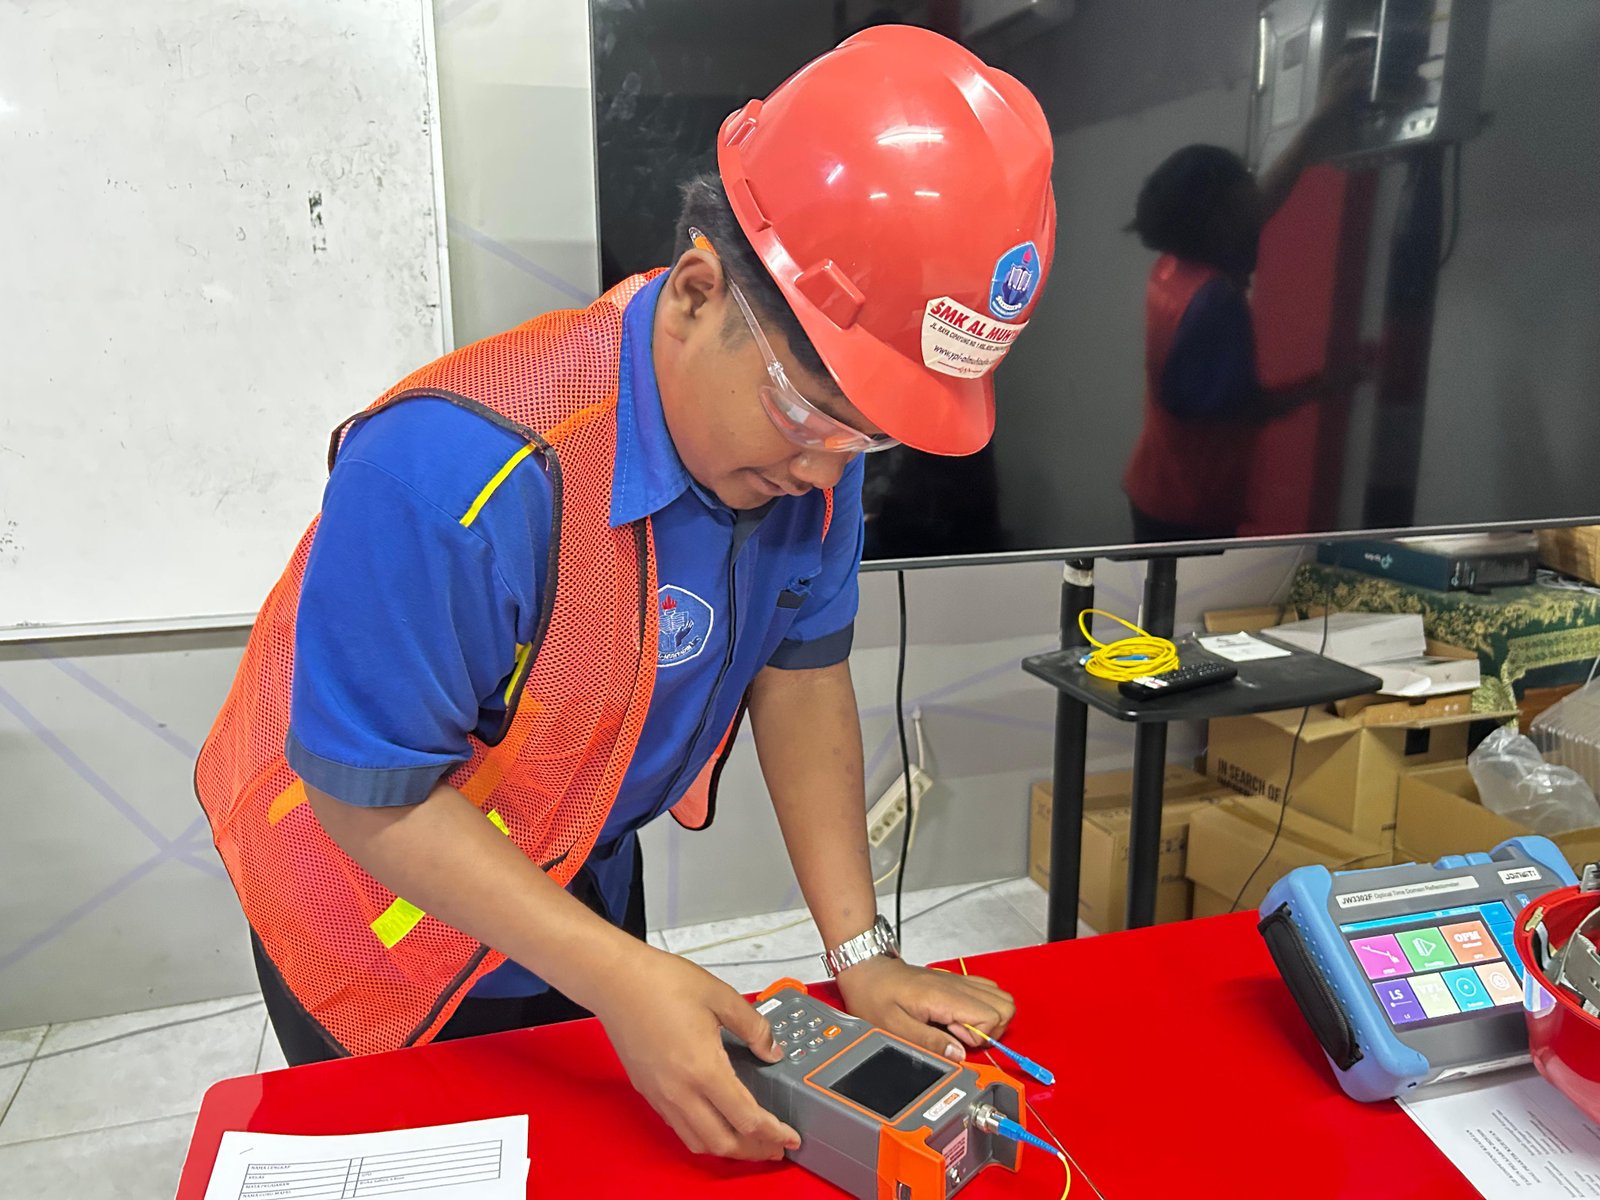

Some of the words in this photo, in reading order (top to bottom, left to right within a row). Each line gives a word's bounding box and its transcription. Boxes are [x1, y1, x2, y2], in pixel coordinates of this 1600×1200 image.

[930, 301, 969, 329] SMK
[966, 320, 987, 336] AL
[937, 325, 951, 336] RAYA
[1218, 757, 1228, 776] IN
[1229, 764, 1266, 796] SEARCH
[1388, 989, 1404, 1000] LS
